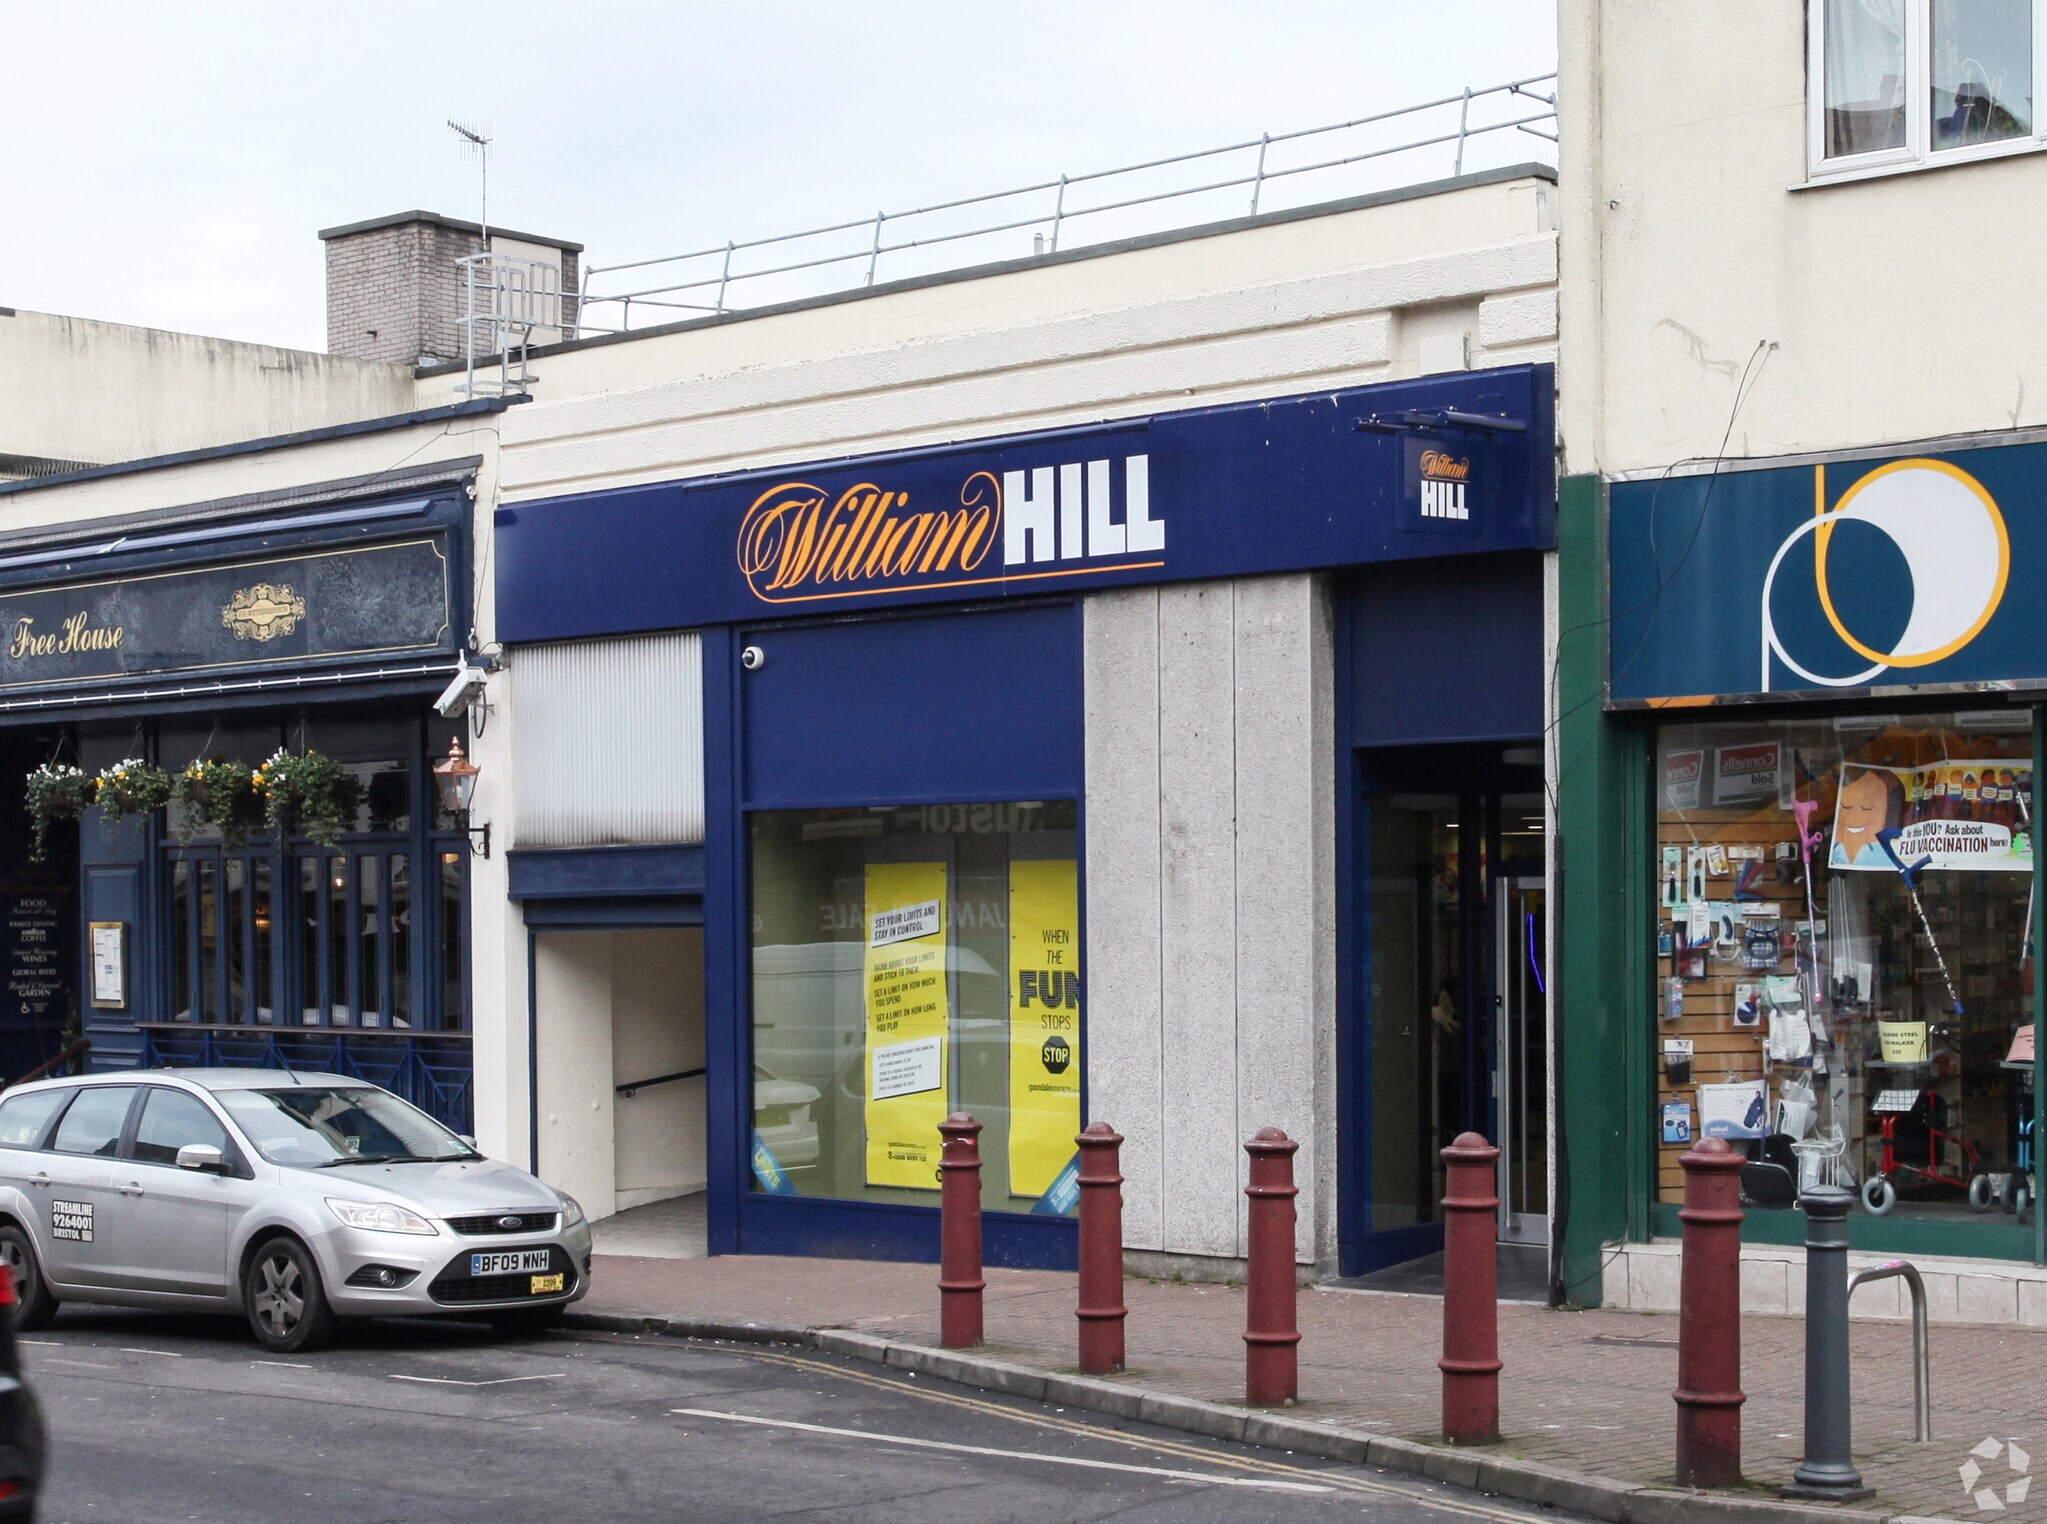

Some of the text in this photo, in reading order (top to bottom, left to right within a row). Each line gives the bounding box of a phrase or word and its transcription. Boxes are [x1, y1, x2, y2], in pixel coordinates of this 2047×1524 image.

[1421, 449, 1469, 480] William
[1421, 480, 1469, 520] HILL
[737, 454, 1165, 594] William HILL
[10, 611, 123, 658] Free House
[1907, 829, 1912, 838] Is
[1922, 822, 1942, 836] YOU?
[1945, 824, 1960, 835] Ask
[1961, 824, 1983, 835] about
[1900, 841, 1916, 855] FLU
[1917, 837, 1988, 853] VACCINATION
[20, 899, 47, 907] FOOD
[875, 905, 936, 929] SET YOUR LIMITS AND
[874, 922, 924, 941] STAY IN CONTROL
[1042, 930, 1069, 944] WHEN
[905, 955, 918, 967] YOUR
[918, 952, 935, 963] LIMITS
[1047, 950, 1063, 965] THE
[874, 971, 884, 982] AND
[884, 969, 898, 980] STICK
[898, 968, 905, 977] TO
[874, 977, 936, 998] SET A LIMIT ON HOW MUCH
[1019, 969, 1080, 1009] FUN
[875, 995, 901, 1008] YOU SPEND
[876, 1002, 936, 1022] SET A LIMIT ON HOW LONG
[876, 1020, 899, 1032] YOU PLAY
[1041, 1014, 1071, 1030] STOPS
[1043, 1048, 1069, 1063] STOP
[53, 1200, 93, 1216] STREAMLINE
[53, 1213, 92, 1230] 9264001
[53, 1227, 80, 1240] BRISTOL
[481, 1251, 548, 1272] BF09 WNH
